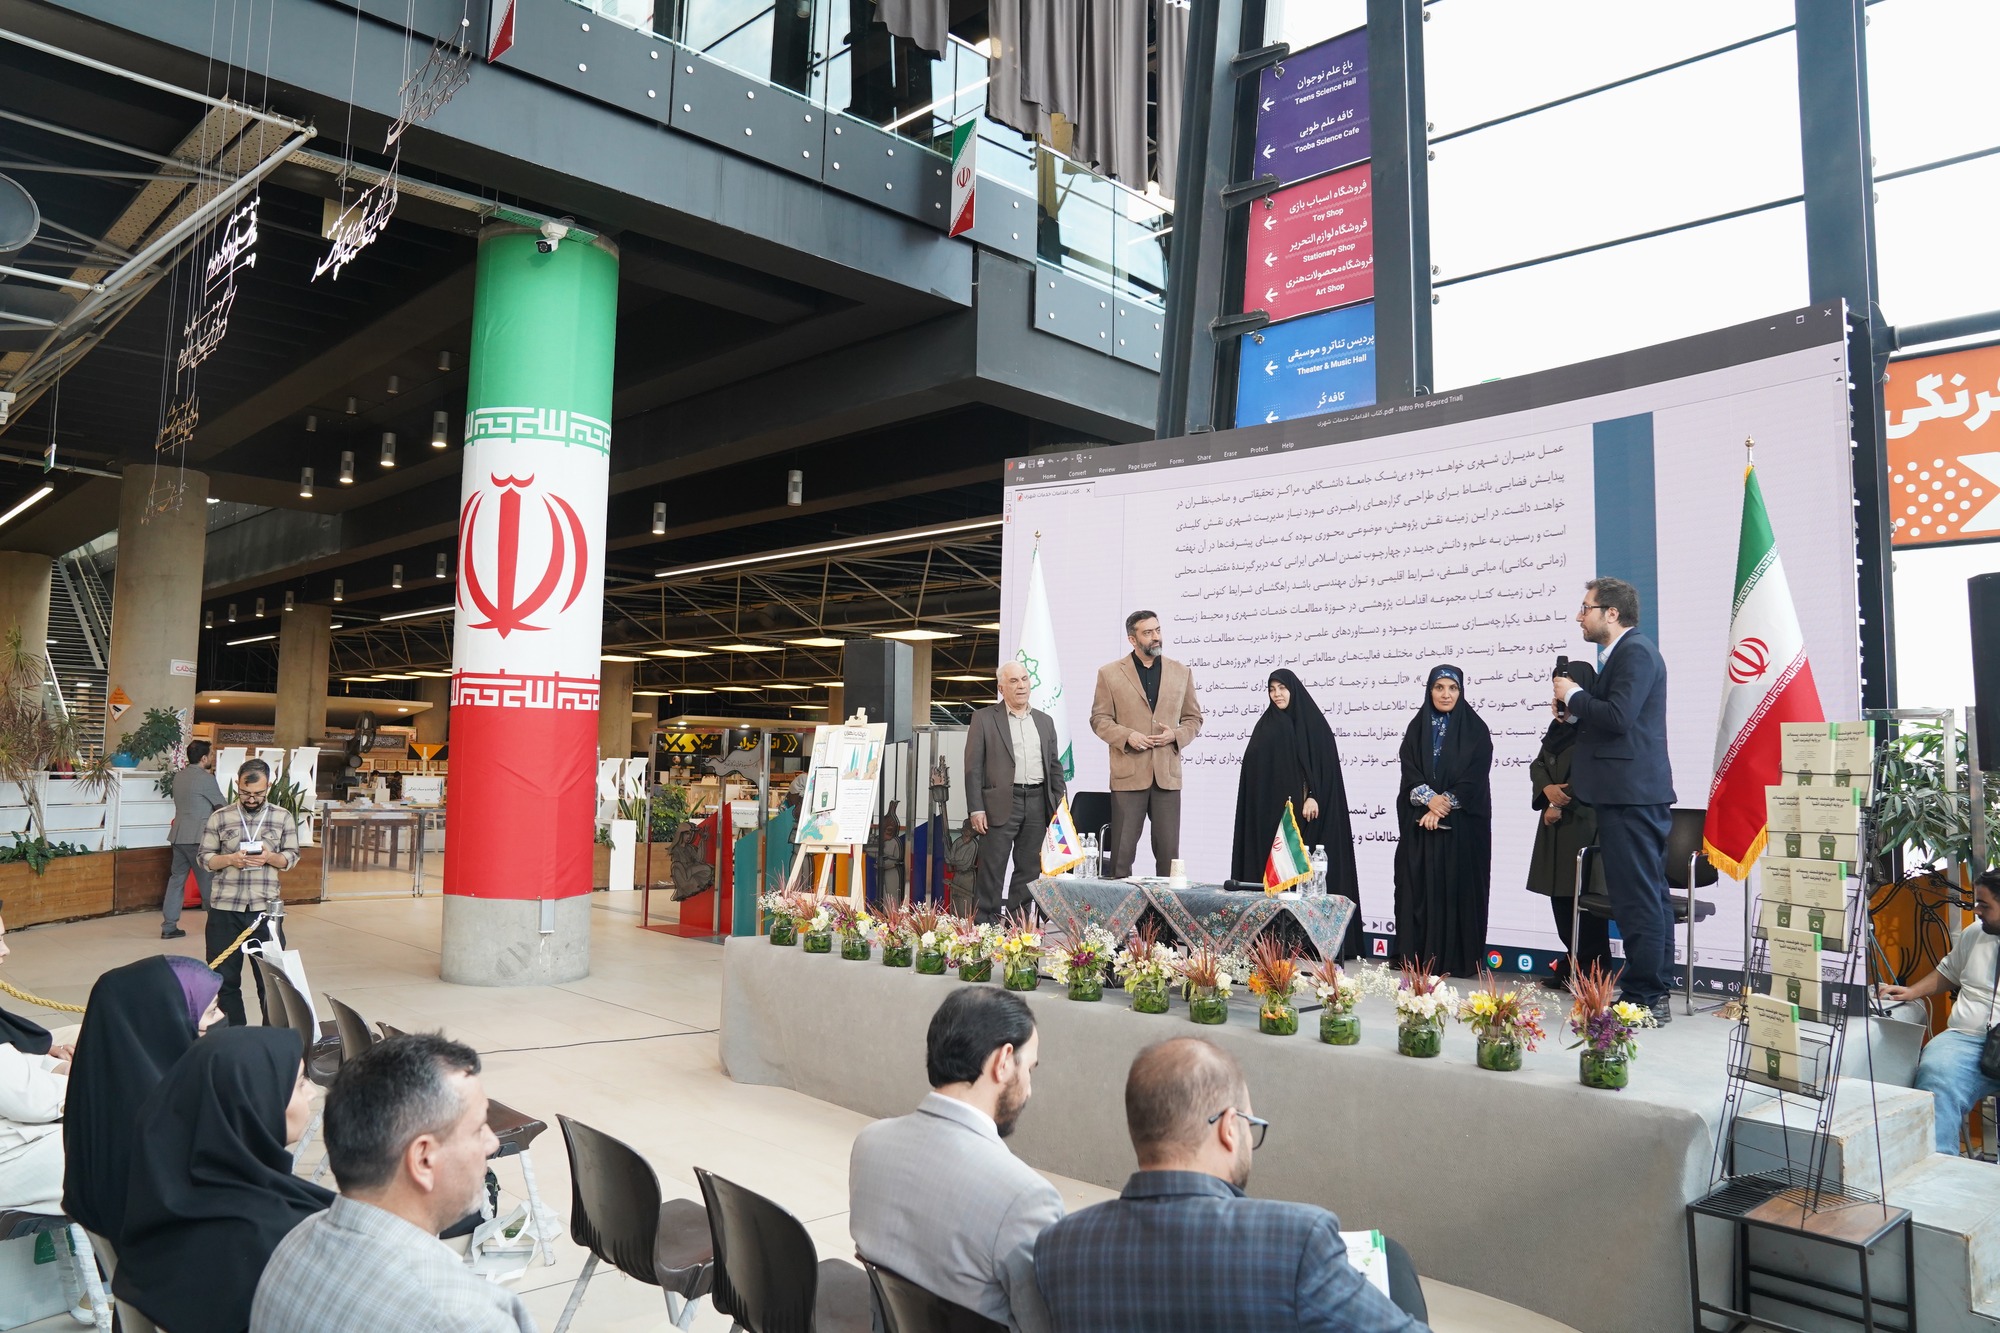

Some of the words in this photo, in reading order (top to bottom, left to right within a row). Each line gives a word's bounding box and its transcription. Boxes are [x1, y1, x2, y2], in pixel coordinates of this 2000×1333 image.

[1326, 66, 1340, 80] علم
[1343, 60, 1353, 74] باغ
[1297, 70, 1324, 89] نوجوان
[1295, 95, 1314, 104] Teens
[1316, 84, 1341, 97] Science
[1343, 77, 1356, 87] Hall
[1337, 109, 1353, 121] کافه
[1300, 122, 1319, 137] طوبی
[1321, 117, 1335, 131] علم
[1295, 142, 1315, 153] Tooba
[1316, 134, 1342, 146] Science
[1344, 127, 1359, 137] Cafe
[1334, 179, 1367, 198] فروشگاه
[1307, 191, 1332, 208] اسباب
[1290, 200, 1304, 214] بازی
[1313, 213, 1324, 221] Toy
[1326, 208, 1343, 217] Shop
[1335, 218, 1367, 235] فروشگاه
[1303, 249, 1336, 262] Stationary
[1338, 244, 1355, 252] Shop
[1342, 254, 1373, 271] فروشگاه
[1305, 266, 1342, 280] محصولات
[1286, 276, 1305, 288] هنری
[1327, 283, 1344, 293] Shop
[1326, 339, 1345, 354] تئاتر
[1347, 335, 1375, 349] پردیس
[1288, 347, 1319, 362] موسیقی
[1297, 365, 1322, 375] Theater
[1331, 358, 1351, 368] Music
[1353, 354, 1366, 363] Hall
[1328, 392, 1345, 403] کافه
[1426, 398, 1448, 408] (Expired
[1450, 394, 1463, 404] Trial)
[1886, 373, 2000, 439] رنگی
[1502, 451, 1535, 465] مدیران
[1538, 445, 1564, 459] عمل
[1436, 460, 1463, 473] خواهد
[1467, 455, 1498, 470] شهری
[1416, 469, 1433, 478] بود
[1530, 471, 1564, 488] پیدایش
[1277, 484, 1300, 498] مراکز
[1495, 476, 1527, 493] فضایی
[1239, 489, 1274, 503] تحقیقاتی
[1404, 490, 1434, 506] طراحی
[1437, 487, 1459, 501] برای
[1177, 501, 1183, 509] در
[1327, 501, 1361, 515] راهبردی
[1534, 498, 1565, 512] خواهند
[1254, 513, 1284, 523] مدیریت
[1287, 508, 1302, 520] نیاز
[1304, 509, 1324, 518] مورد
[1446, 513, 1468, 524] زمینه
[1471, 508, 1488, 523] این
[1491, 510, 1499, 520] در
[1176, 519, 1201, 532] کلیدی
[1203, 517, 1223, 530] نقش
[1226, 515, 1251, 527] شهری
[1421, 515, 1443, 529] نقش
[1281, 532, 1293, 542] که
[1315, 531, 1344, 541] محوری
[1347, 525, 1382, 538] موضوعی
[1543, 525, 1565, 537] است
[1255, 536, 1278, 547] مبنای
[1295, 534, 1311, 543] بوده
[1469, 536, 1487, 549] علم
[1489, 537, 1501, 545] به
[1503, 535, 1534, 546] رسیدن
[1176, 544, 1195, 554] نهفته
[1198, 539, 1206, 553] آن
[1208, 543, 1215, 552] در
[1403, 547, 1410, 557] در
[1413, 545, 1434, 554] جدید
[1437, 539, 1460, 554] دانش
[1308, 552, 1337, 567] اسلامی
[1339, 551, 1361, 564] تمدن
[1364, 546, 1400, 561] چهارچوب
[1198, 563, 1230, 574] مقتضیات
[1270, 557, 1282, 567] که
[1284, 555, 1306, 569] ایرانی
[1471, 562, 1496, 576] مبانی
[1175, 566, 1196, 578] محلی
[1377, 570, 1404, 585] اقلیمی
[1408, 569, 1434, 581] شرایط
[1255, 581, 1289, 595] راهگشای
[1292, 580, 1311, 590] باشد
[1313, 579, 1346, 591] مهندسی
[1349, 575, 1368, 588] توان
[1204, 586, 1226, 599] کنونی
[1229, 585, 1253, 597] شرایط
[1369, 805, 1386, 819] علی
